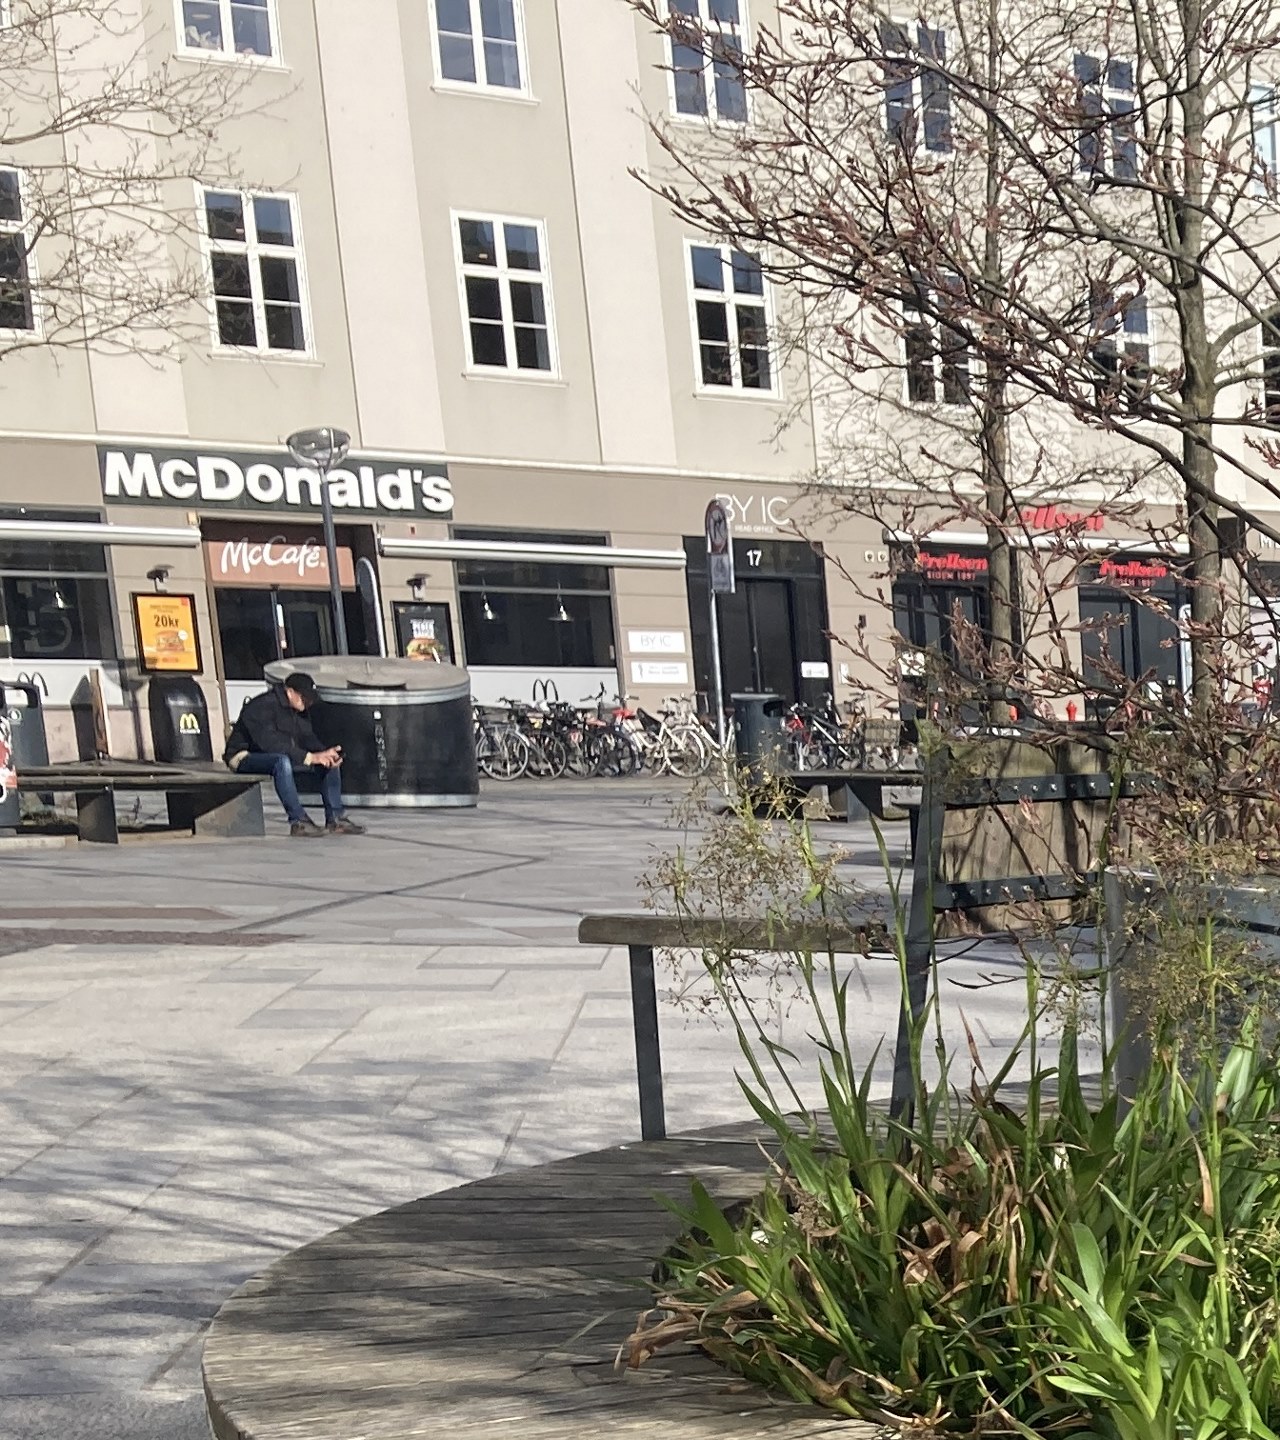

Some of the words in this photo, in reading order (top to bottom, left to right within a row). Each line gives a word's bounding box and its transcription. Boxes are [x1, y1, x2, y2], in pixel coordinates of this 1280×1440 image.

[104, 450, 454, 513] McDonald's
[761, 495, 790, 526] IC
[746, 549, 762, 566] 17
